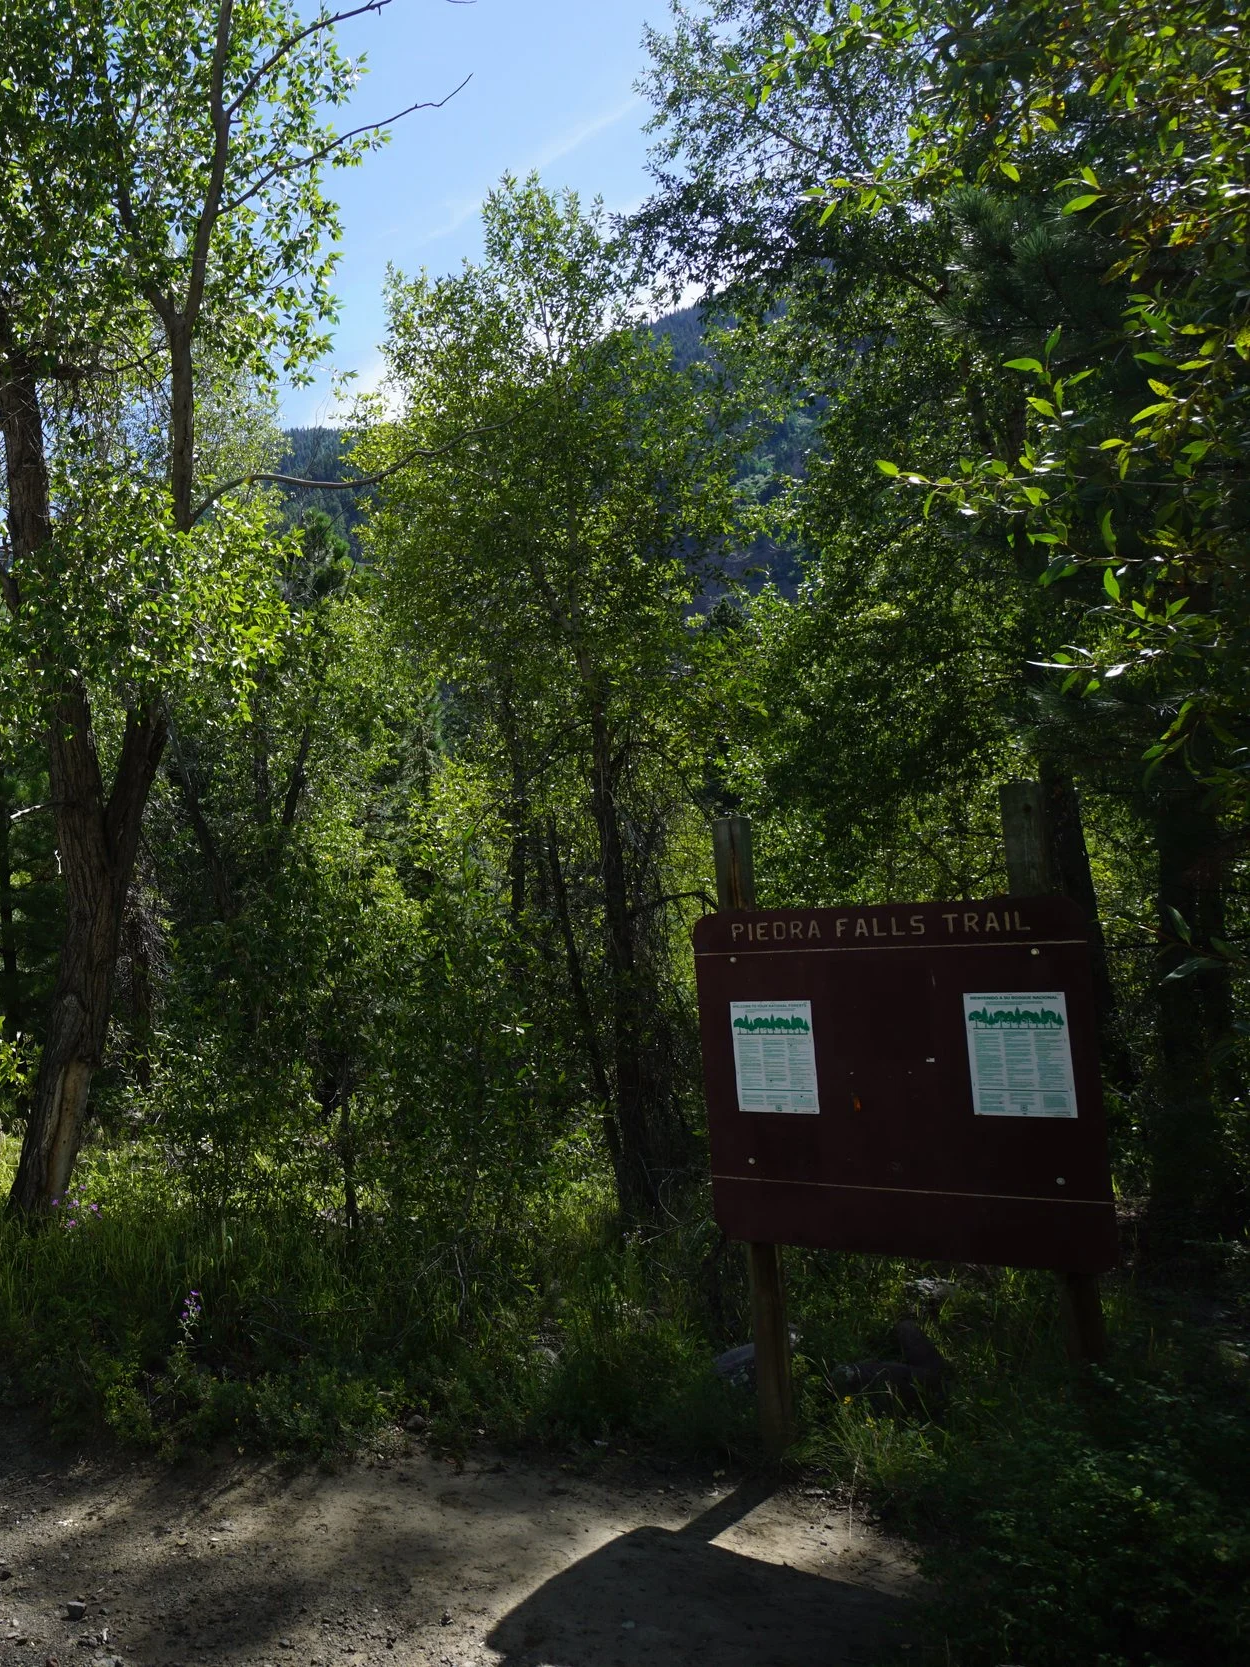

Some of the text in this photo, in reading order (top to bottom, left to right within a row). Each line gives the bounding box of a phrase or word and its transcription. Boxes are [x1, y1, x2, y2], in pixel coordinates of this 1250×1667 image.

[730, 911, 1031, 942] PIEDRA FALLS TRAIL
